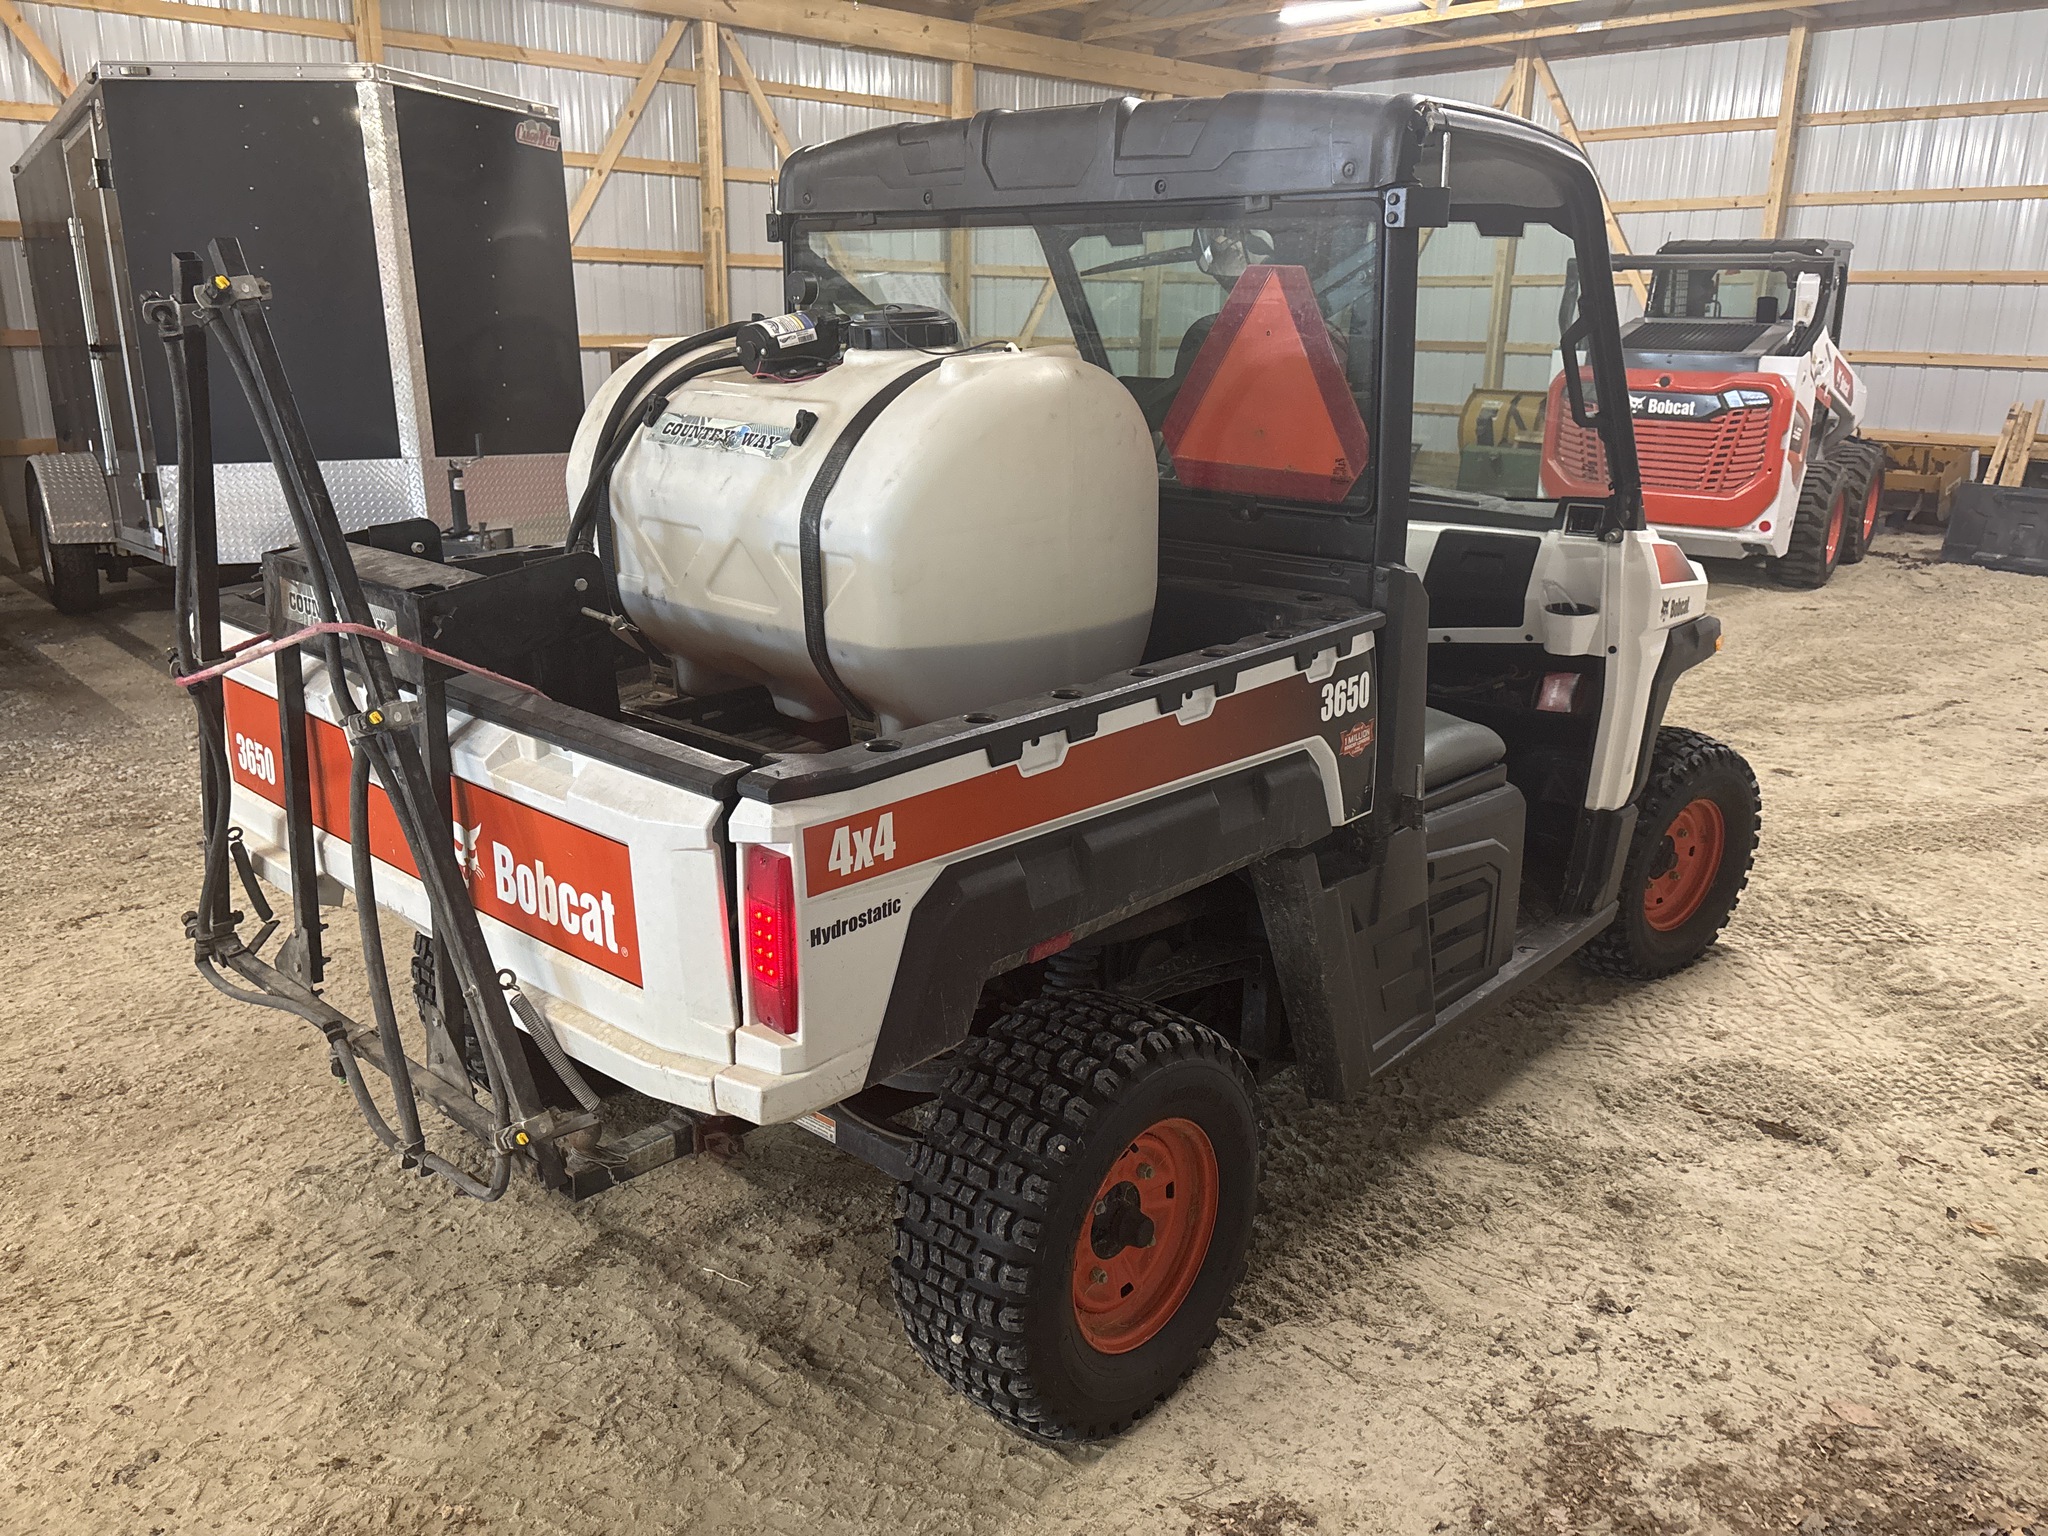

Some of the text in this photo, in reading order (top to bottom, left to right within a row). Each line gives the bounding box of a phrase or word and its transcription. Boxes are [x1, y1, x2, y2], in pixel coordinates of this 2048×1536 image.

[1647, 398, 1696, 416] Bobcat
[662, 422, 780, 450] COUNTRY WAY
[1670, 596, 1690, 619] Bobcat
[1320, 671, 1370, 722] 3650
[235, 732, 276, 786] 3650
[828, 811, 897, 877] 4x4
[492, 840, 619, 954] Bobcat
[810, 898, 901, 948] Hydrostatic
